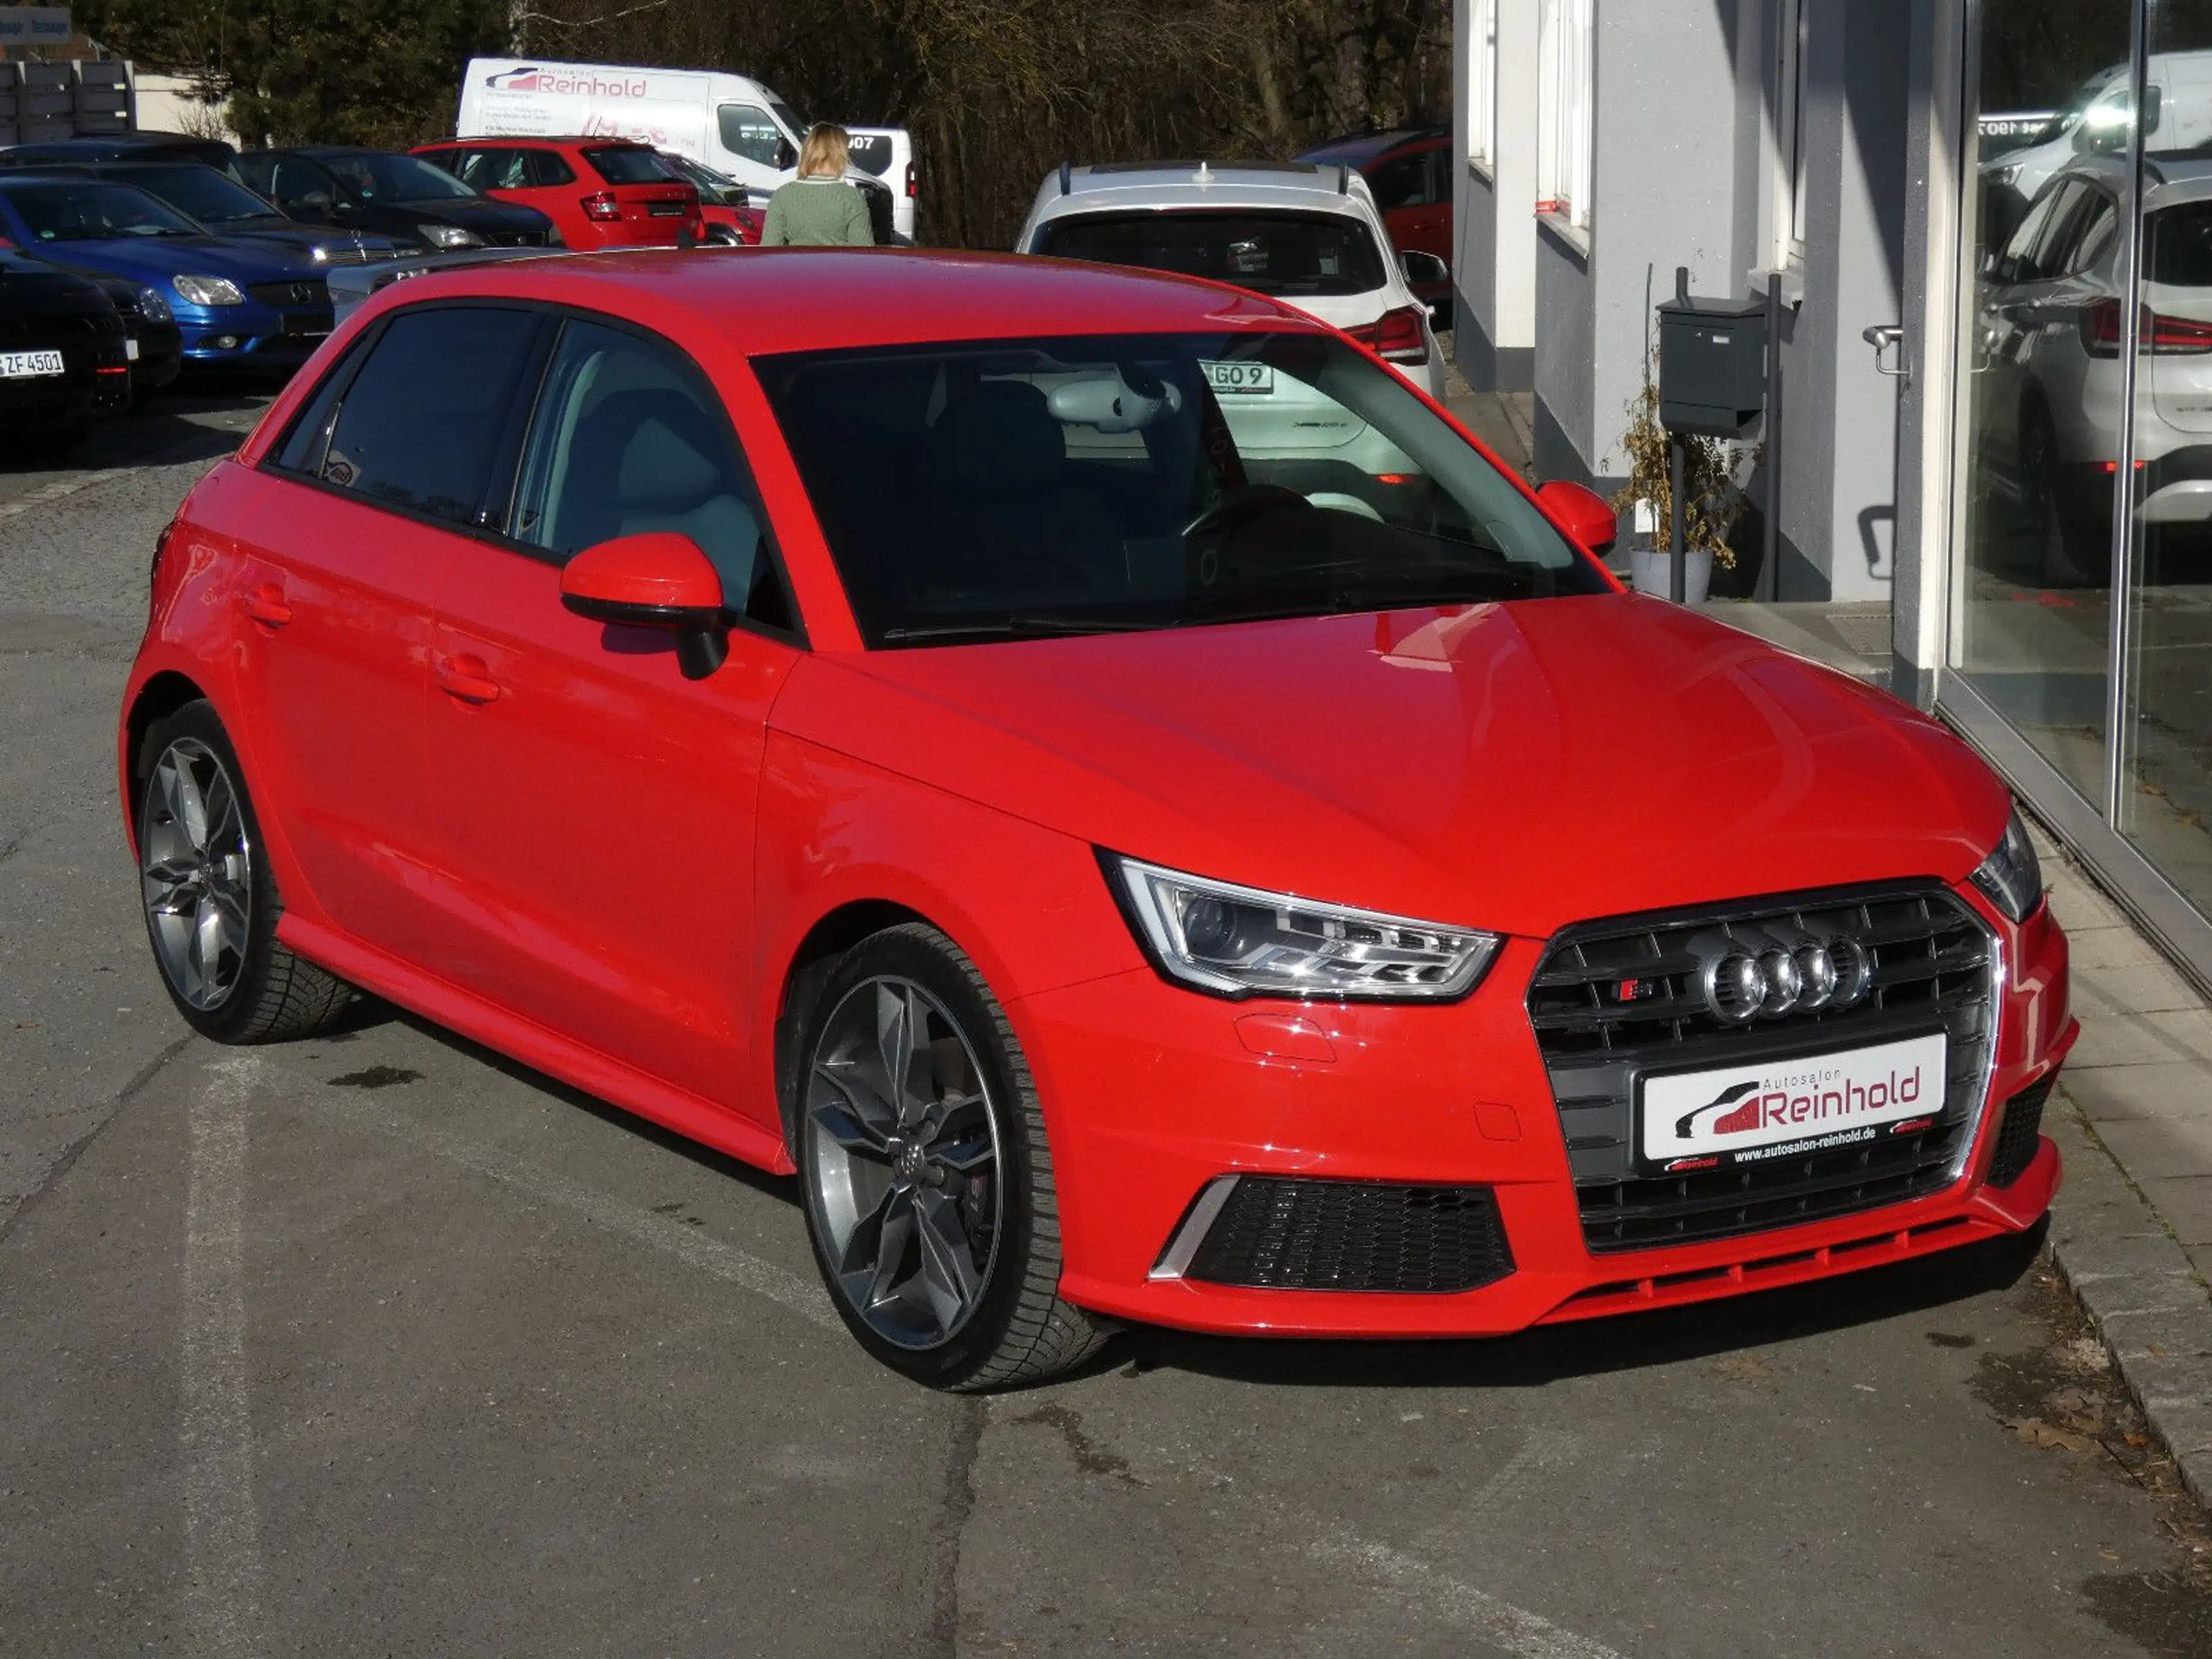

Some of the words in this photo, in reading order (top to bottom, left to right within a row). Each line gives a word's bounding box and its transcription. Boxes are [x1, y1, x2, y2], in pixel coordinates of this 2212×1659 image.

[538, 74, 646, 97] Reinhold
[6, 355, 23, 373] ZF
[28, 354, 62, 372] 4501
[1215, 366, 1243, 384] GO
[1249, 368, 1263, 385] 9
[1763, 1069, 1840, 1090] Autosalon
[1762, 1066, 1919, 1128] Reinhold
[1735, 1127, 1876, 1162] www.autosalon-reinhold.de
